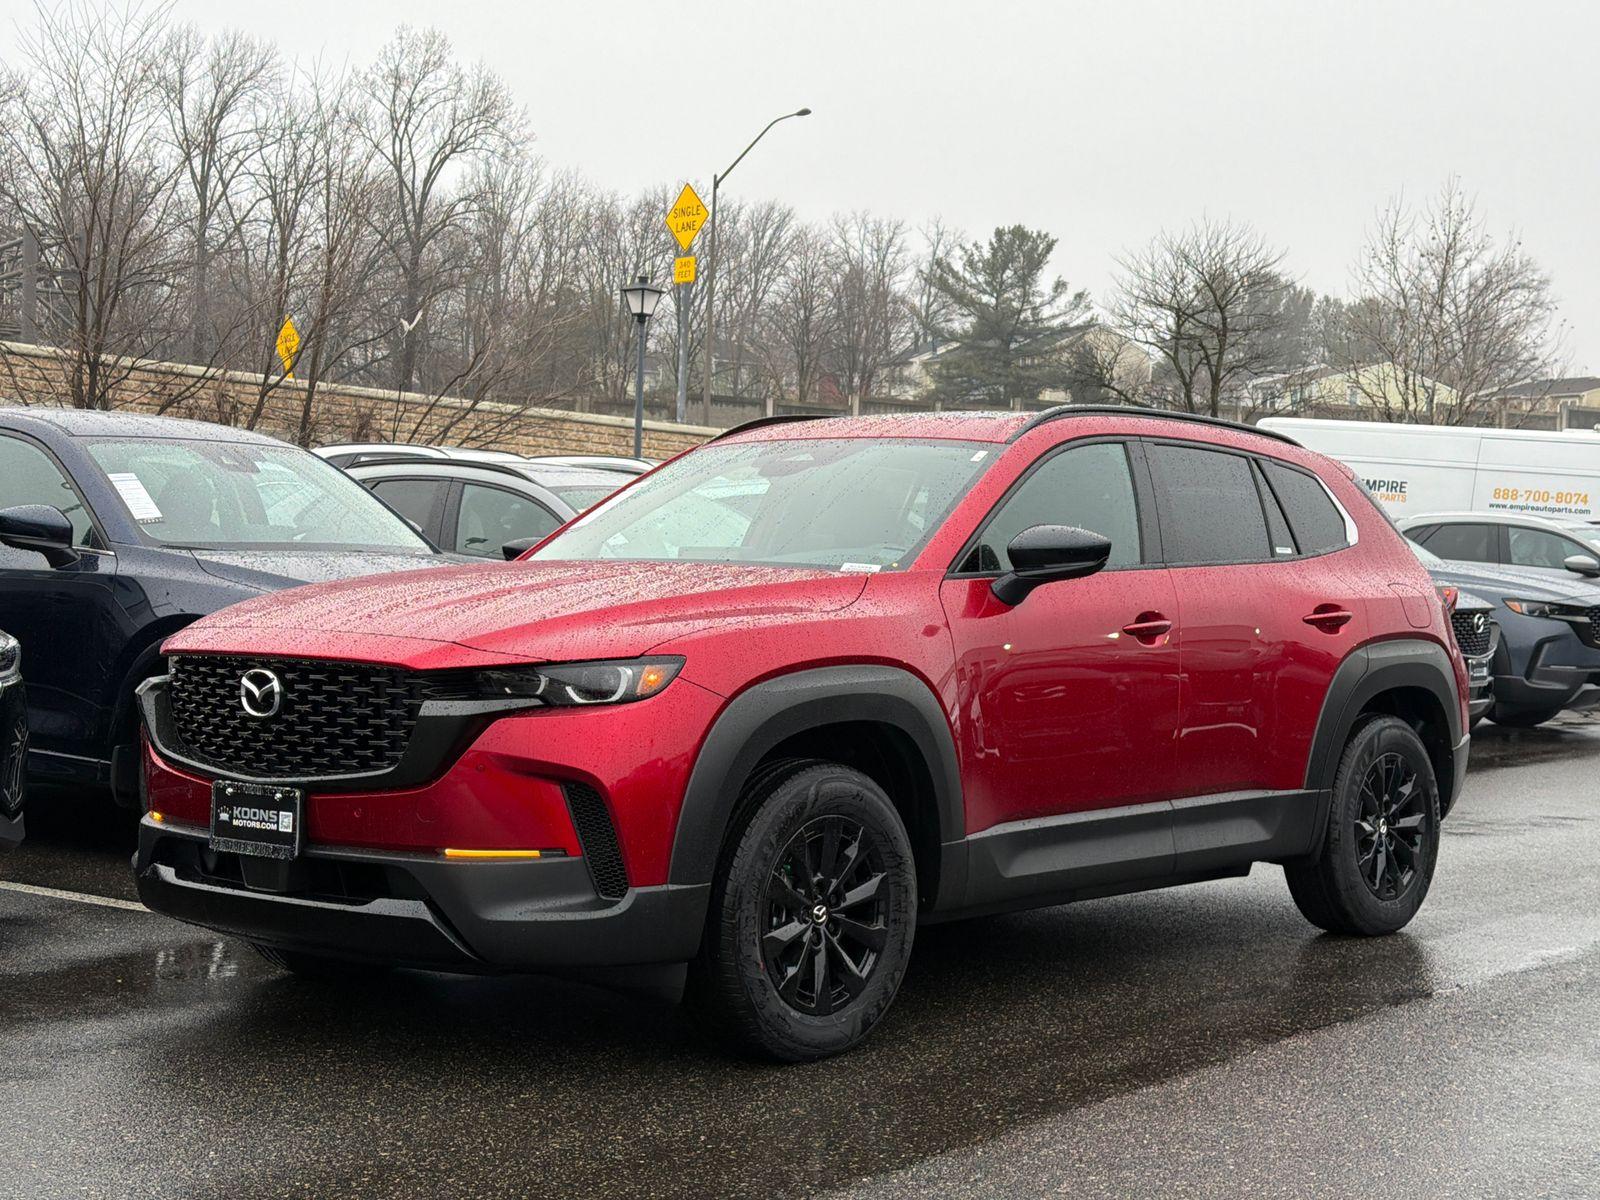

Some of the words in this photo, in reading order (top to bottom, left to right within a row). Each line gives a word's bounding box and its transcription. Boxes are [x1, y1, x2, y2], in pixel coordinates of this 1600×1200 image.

[673, 205, 701, 219] SINGLE
[676, 220, 697, 233] LANE
[1361, 479, 1408, 493] MPIRE
[1379, 493, 1407, 503] PARTS
[1493, 488, 1589, 506] 888-700-8074
[1489, 503, 1591, 514] www.empireautoparts.com
[233, 806, 277, 822] KOONS
[233, 819, 277, 830] MOTORS.COM
